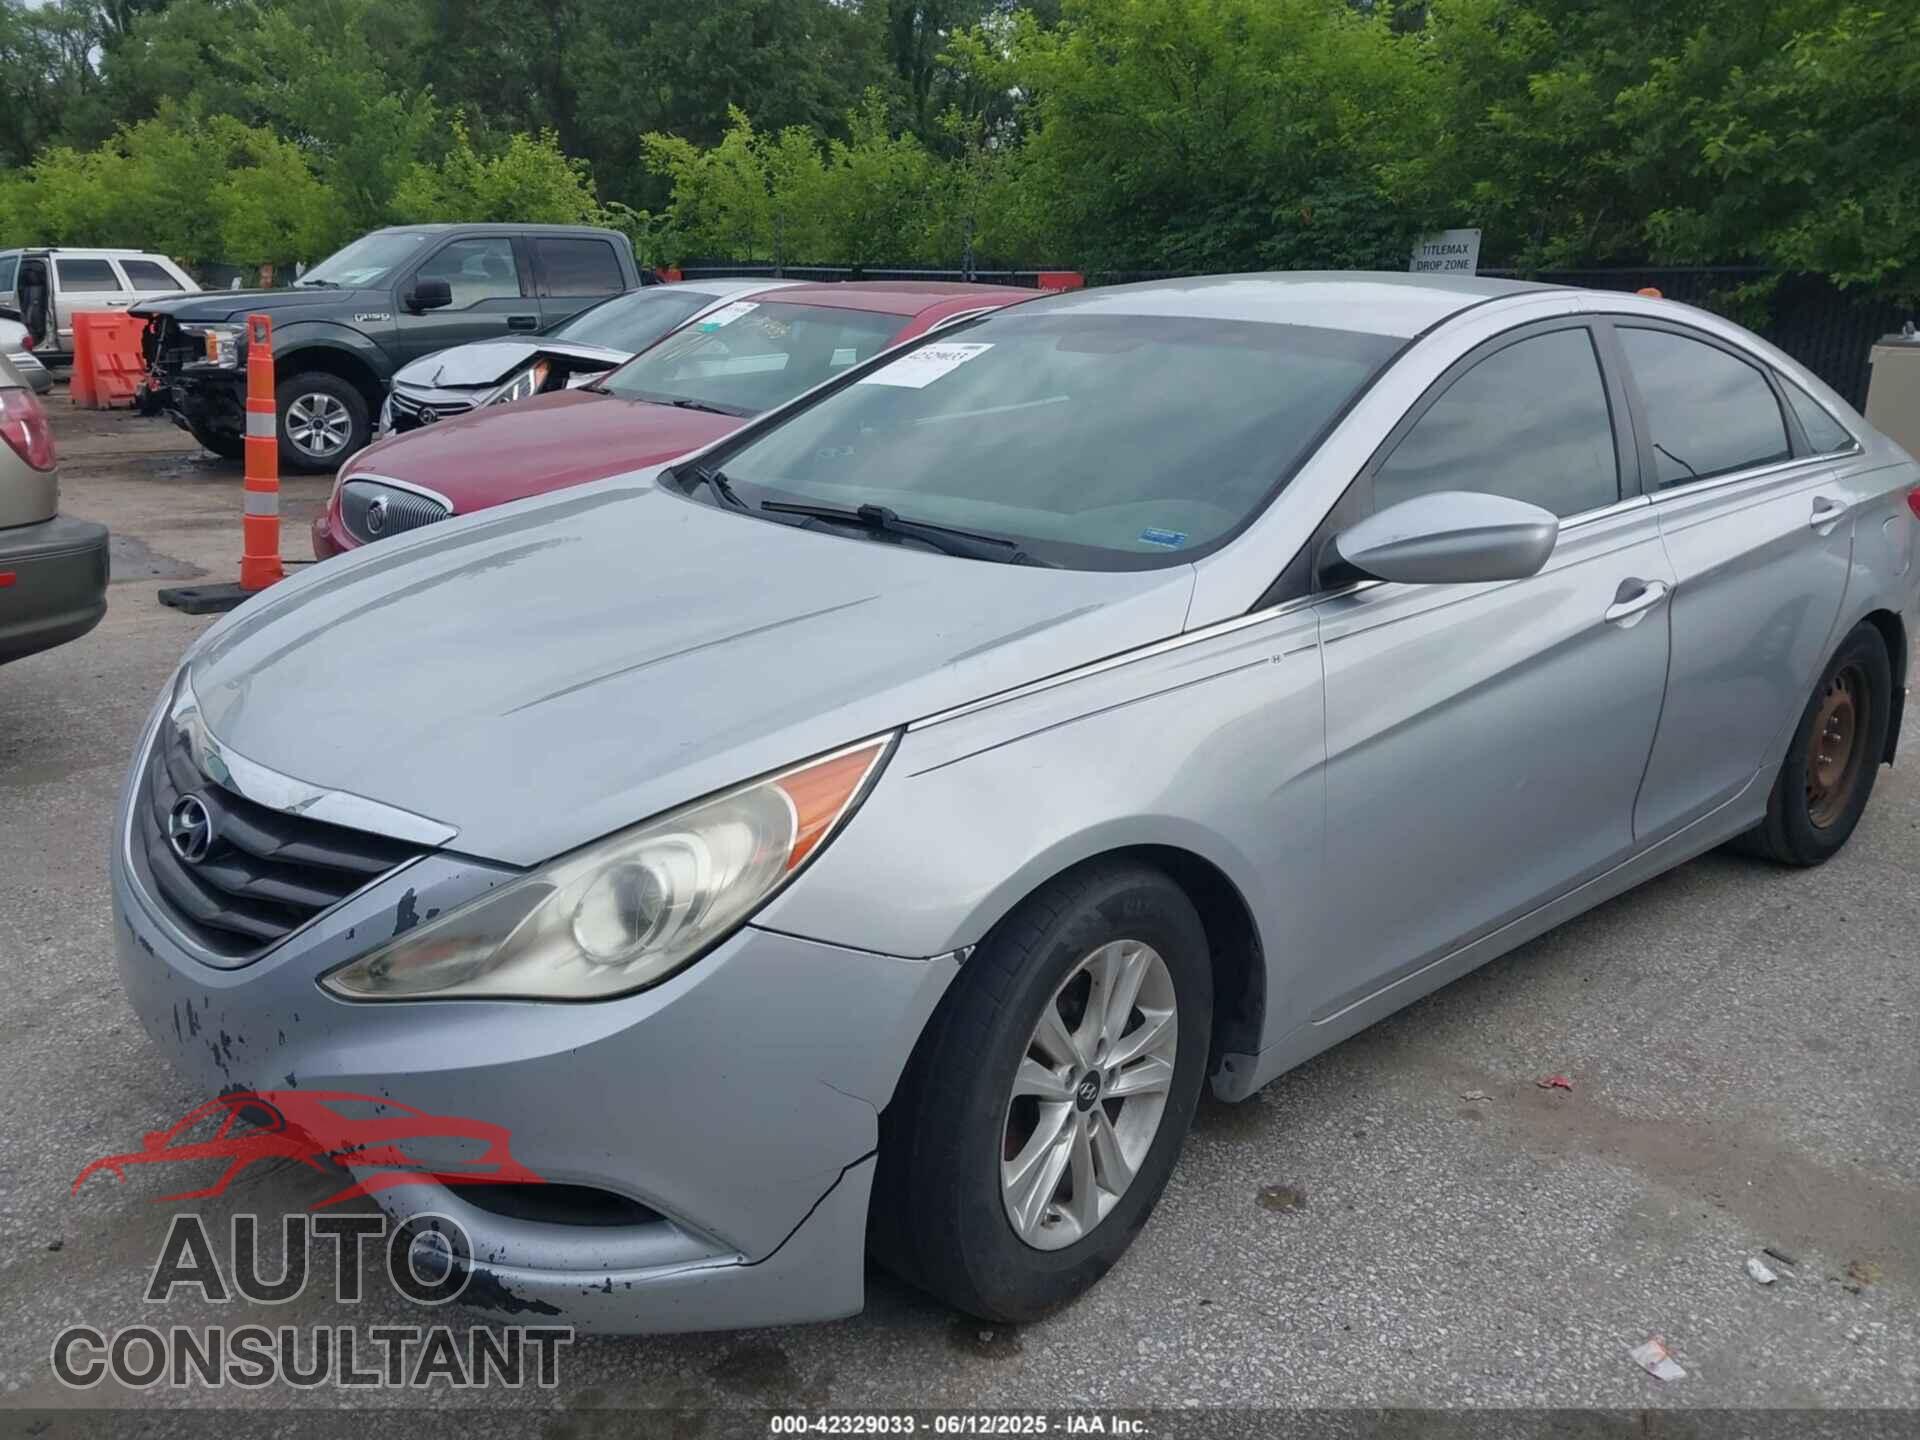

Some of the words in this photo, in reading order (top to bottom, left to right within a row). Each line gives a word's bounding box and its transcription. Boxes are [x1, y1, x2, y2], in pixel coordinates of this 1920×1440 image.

[1422, 243, 1469, 256] TITLEMAX
[1416, 260, 1442, 271] DROP
[1444, 258, 1471, 270] ZONE
